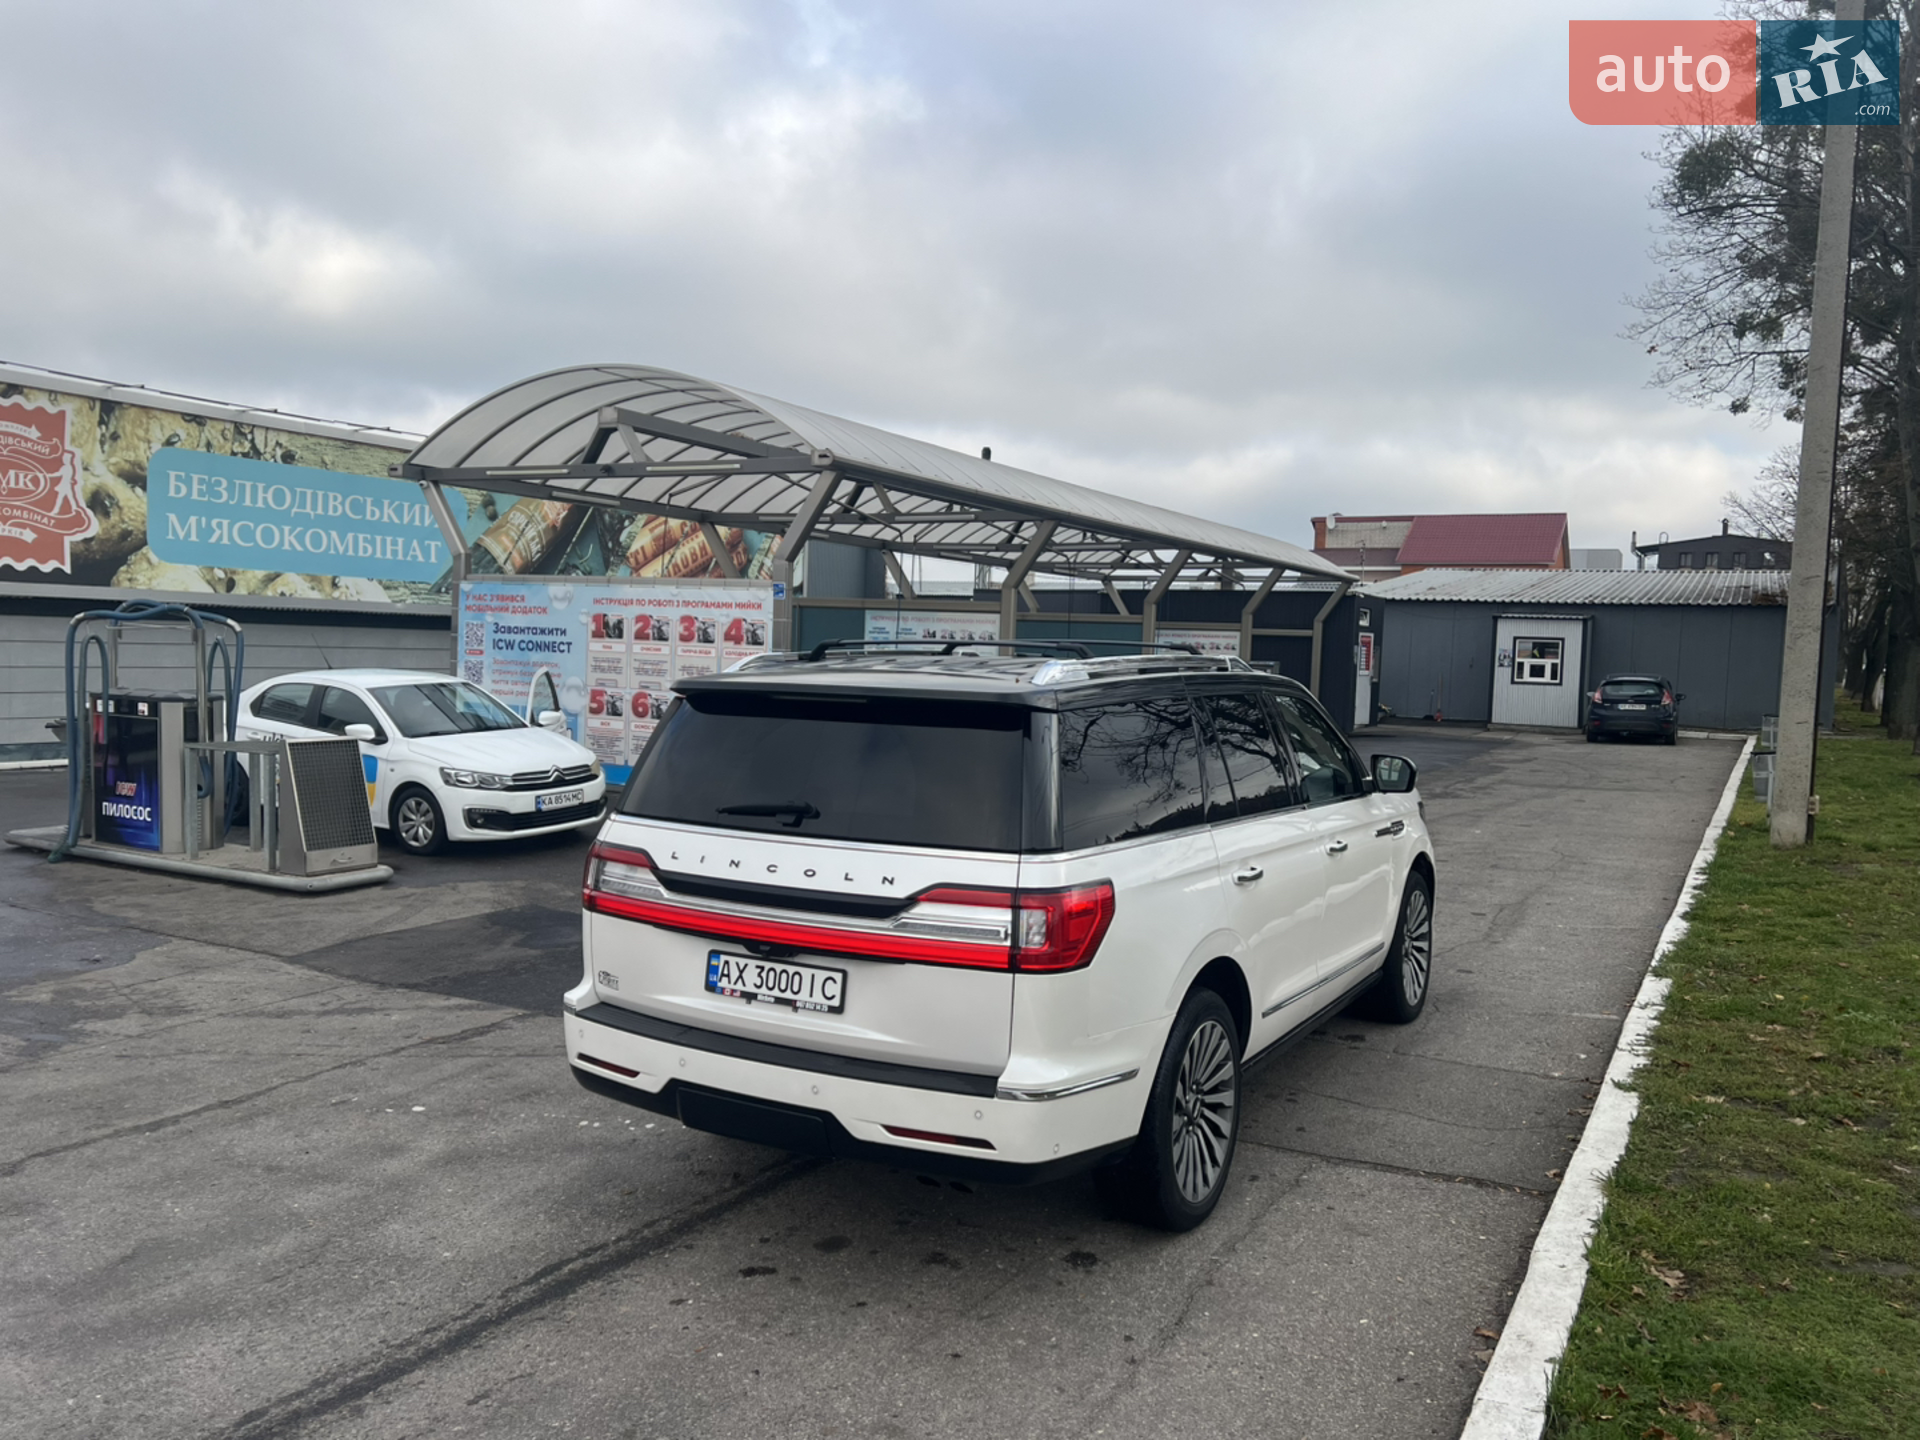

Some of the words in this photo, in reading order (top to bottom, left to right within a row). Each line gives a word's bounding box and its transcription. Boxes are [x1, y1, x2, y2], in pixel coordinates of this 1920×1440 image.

[0, 507, 56, 527] ОМБІНАТ
[165, 512, 442, 564] М'ЯСОКОМБІНАТ
[511, 605, 548, 615] ДОДАТОК
[636, 598, 647, 607] ПО
[648, 598, 674, 608] РОБОТІ
[682, 599, 733, 610] ПРОГРАМАМИ
[734, 599, 763, 611] МИЙКИ
[492, 622, 567, 637] Завантажити
[592, 613, 605, 639] 1
[634, 613, 651, 641] 2
[679, 615, 697, 643] 3
[723, 618, 745, 645] 4
[492, 638, 516, 651] ICW
[517, 639, 573, 654] CONNECT
[589, 688, 605, 715] 5
[632, 691, 650, 718] 6
[102, 801, 152, 822] ПИЛОСОС
[671, 851, 896, 886] LINCOLN
[718, 959, 749, 988] AX
[753, 964, 803, 996] 3000
[809, 973, 838, 1001] IC
